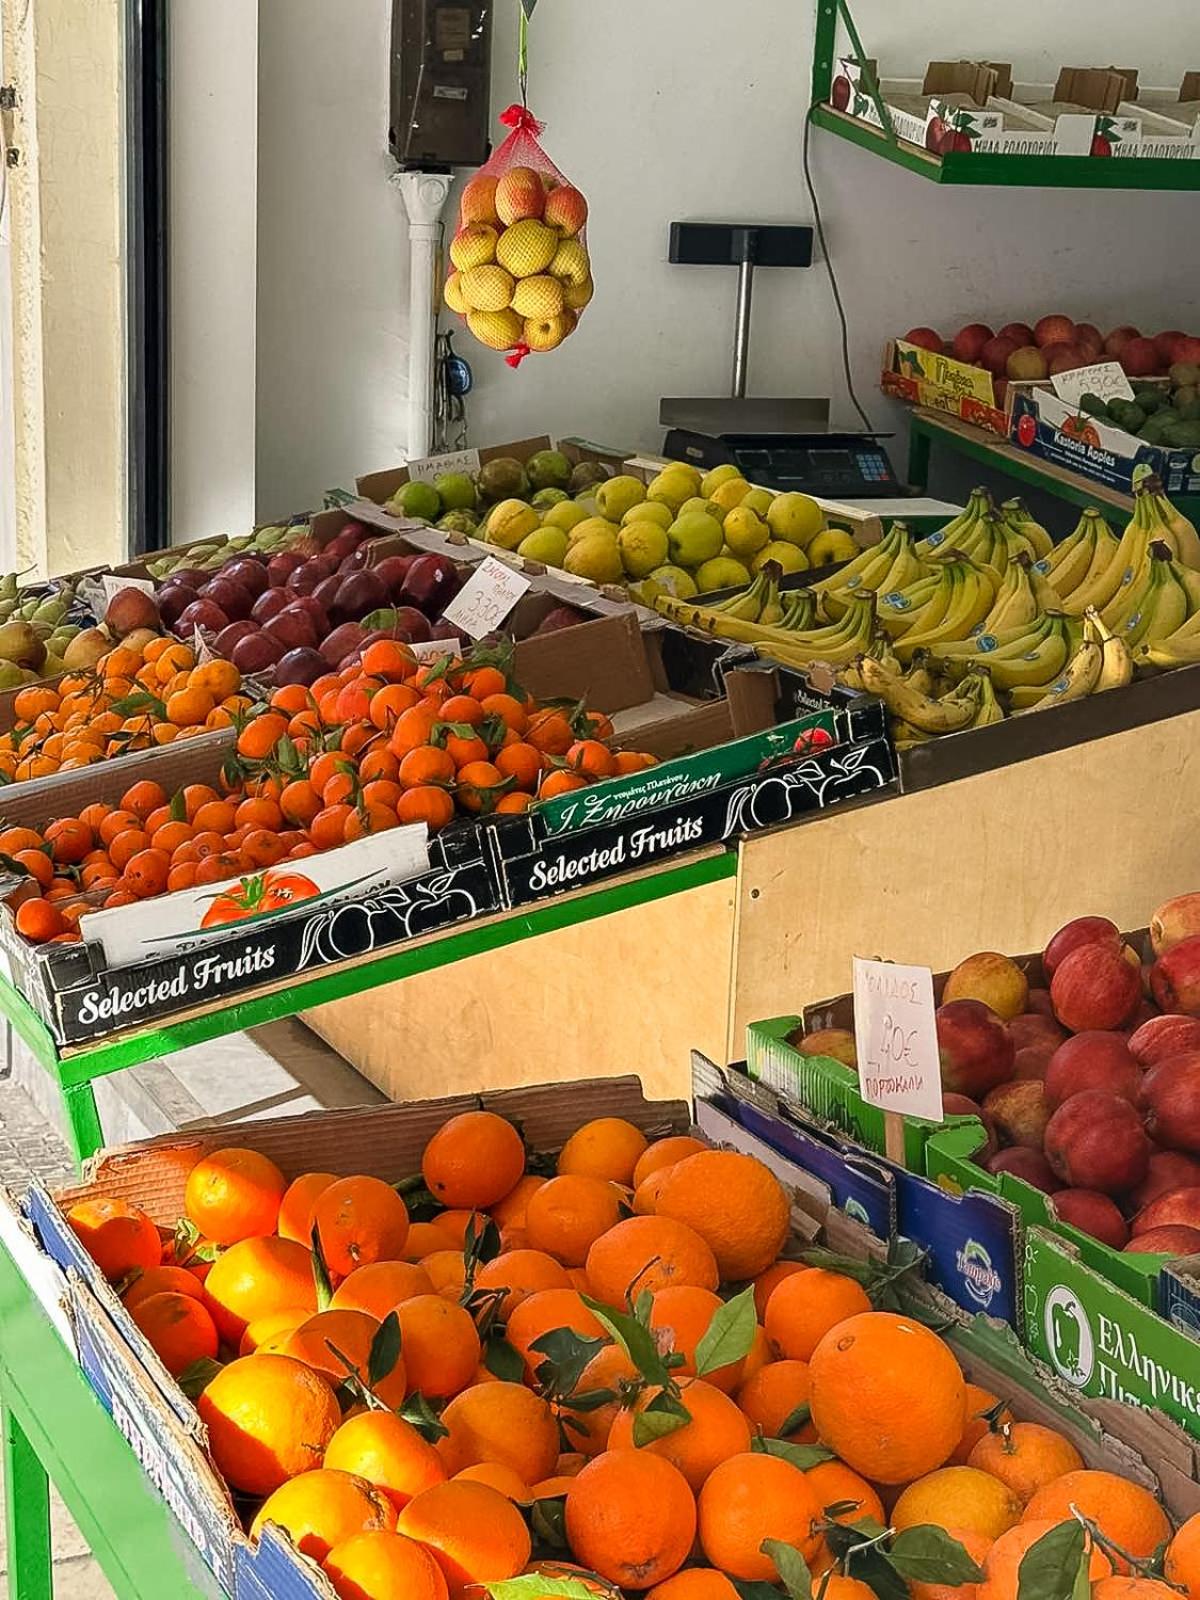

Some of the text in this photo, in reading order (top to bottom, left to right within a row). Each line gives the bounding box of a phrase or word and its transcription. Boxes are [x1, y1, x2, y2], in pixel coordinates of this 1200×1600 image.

[1053, 431, 1086, 455] Kastoria
[1086, 445, 1116, 467] Apples
[528, 815, 703, 891] Selected Fruits
[78, 944, 276, 1024] Selected Fruits
